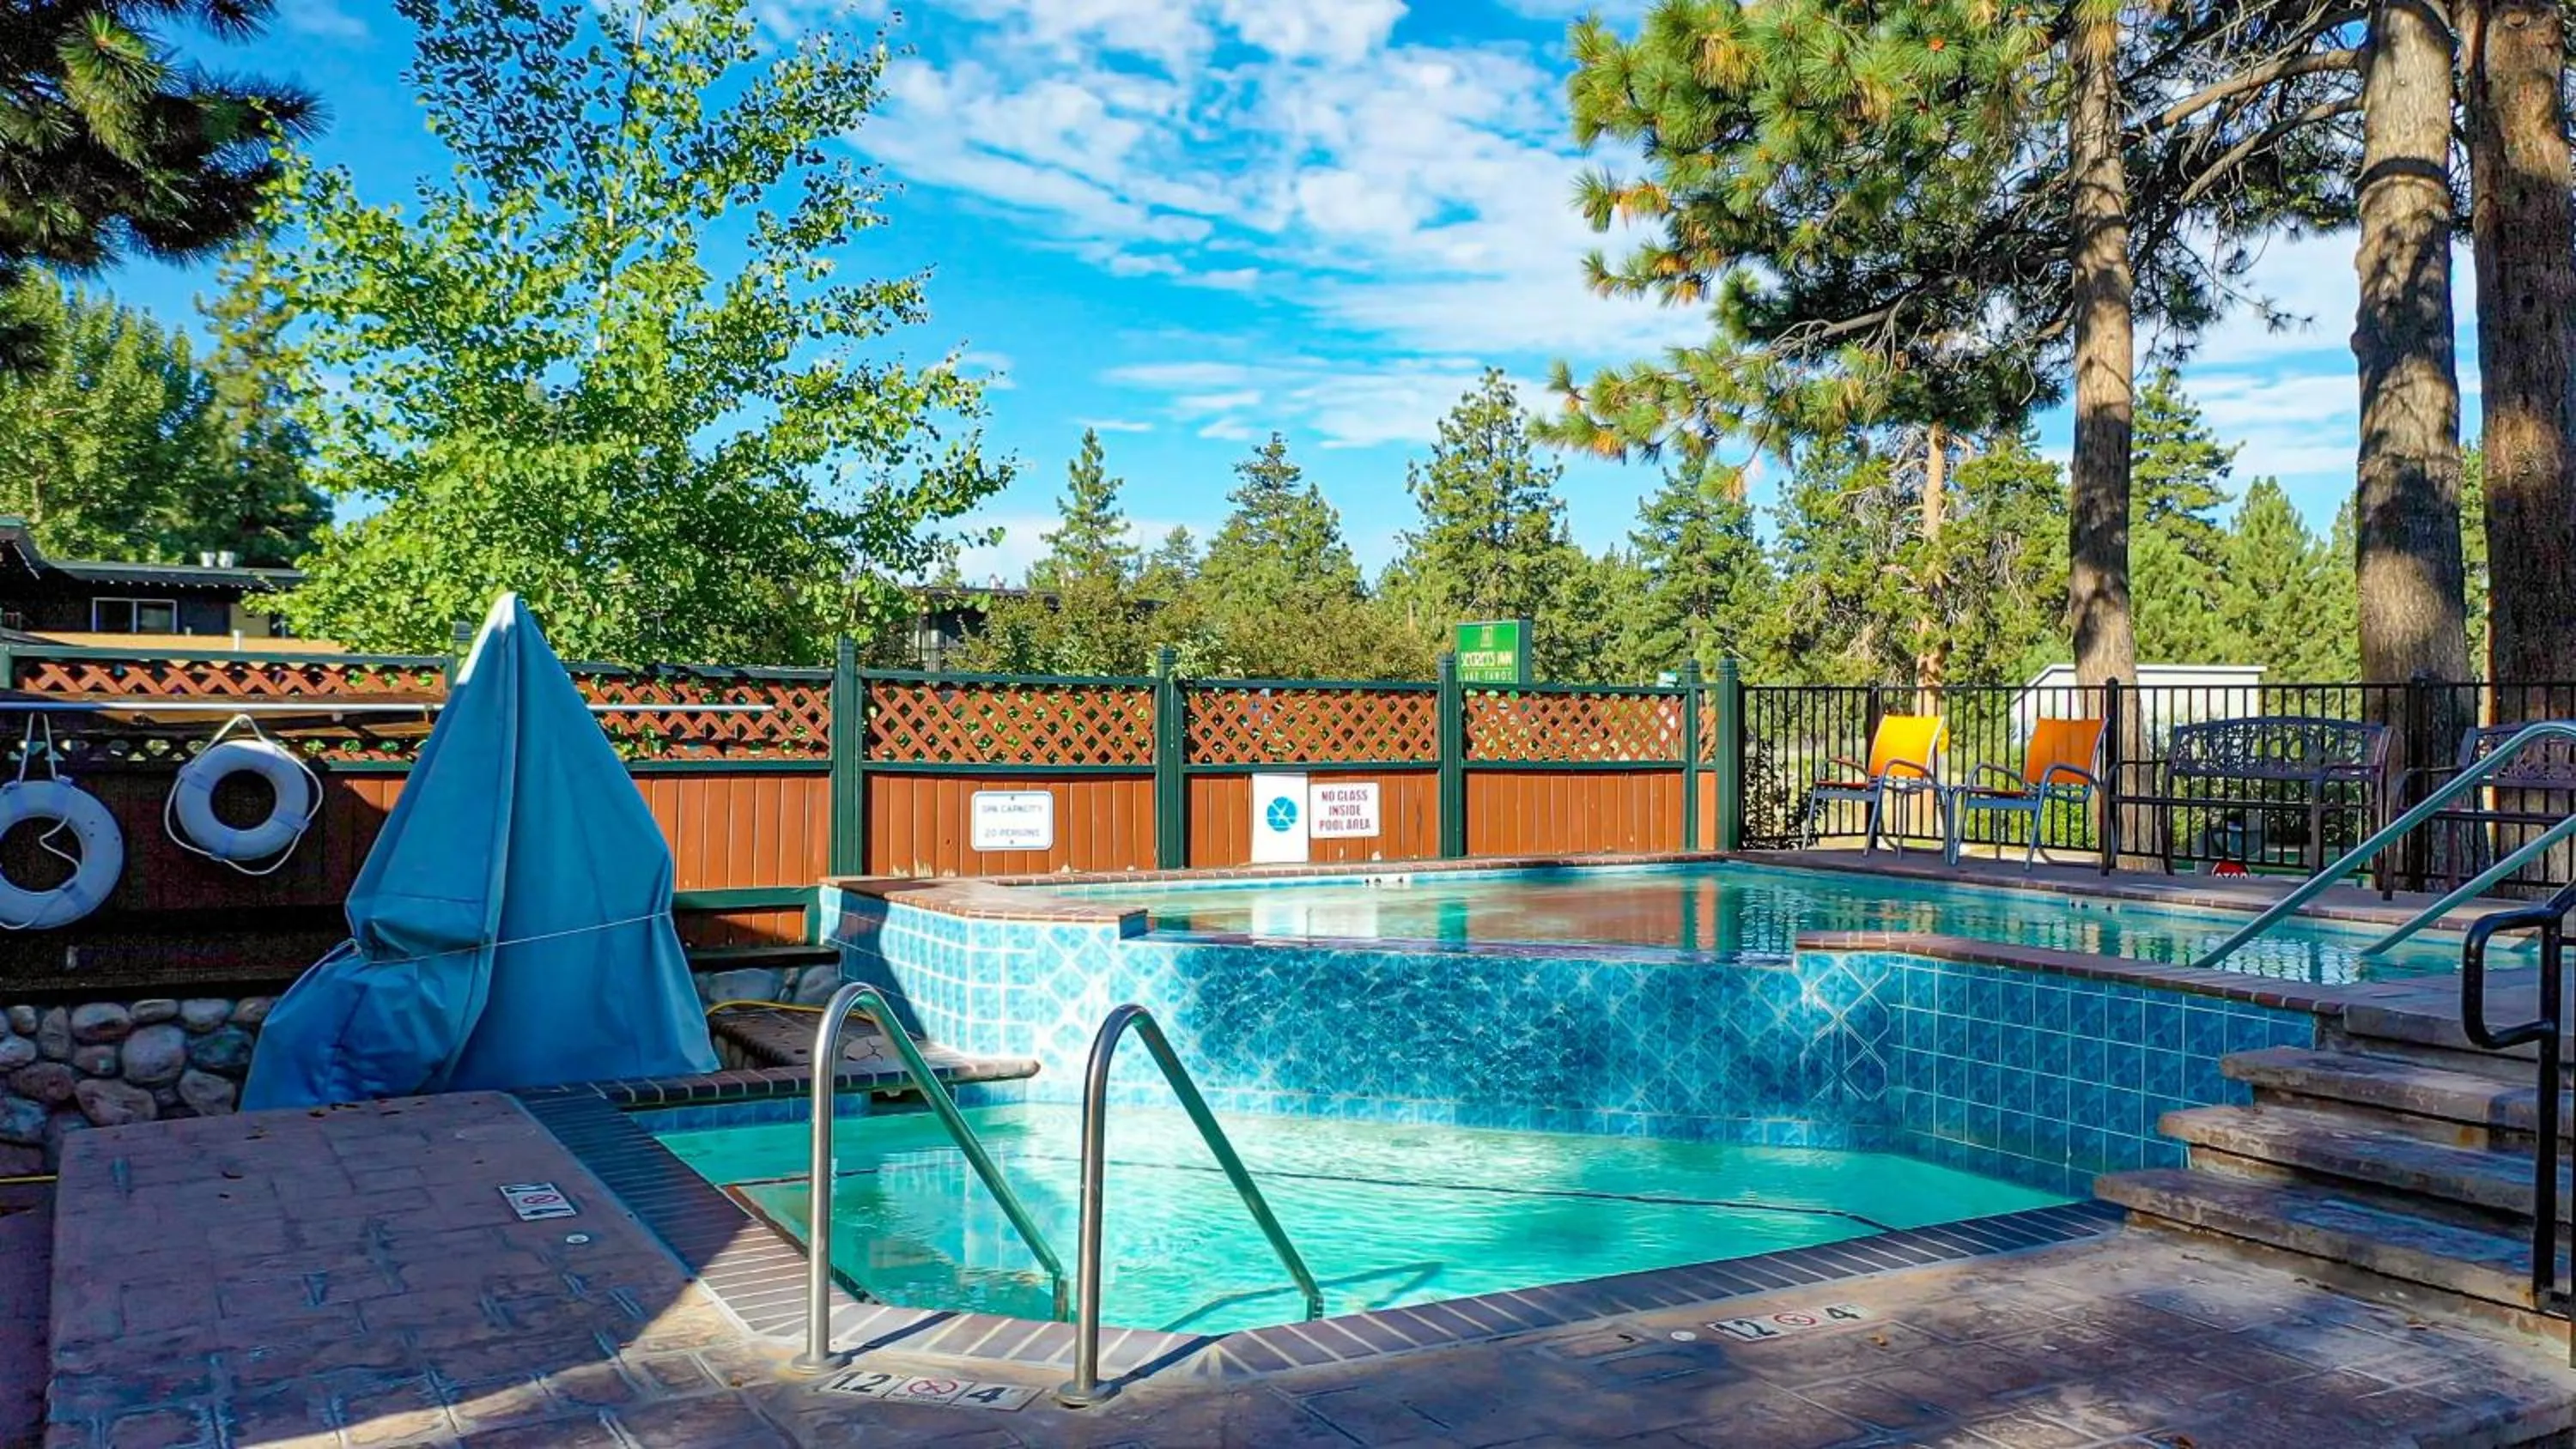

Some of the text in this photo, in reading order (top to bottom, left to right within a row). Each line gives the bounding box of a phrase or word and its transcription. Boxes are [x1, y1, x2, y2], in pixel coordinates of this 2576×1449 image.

[1321, 790, 1335, 802] NO
[1328, 804, 1361, 816] INSIDE
[1319, 818, 1371, 832] POOL AREA
[967, 1387, 1007, 1403] 4
